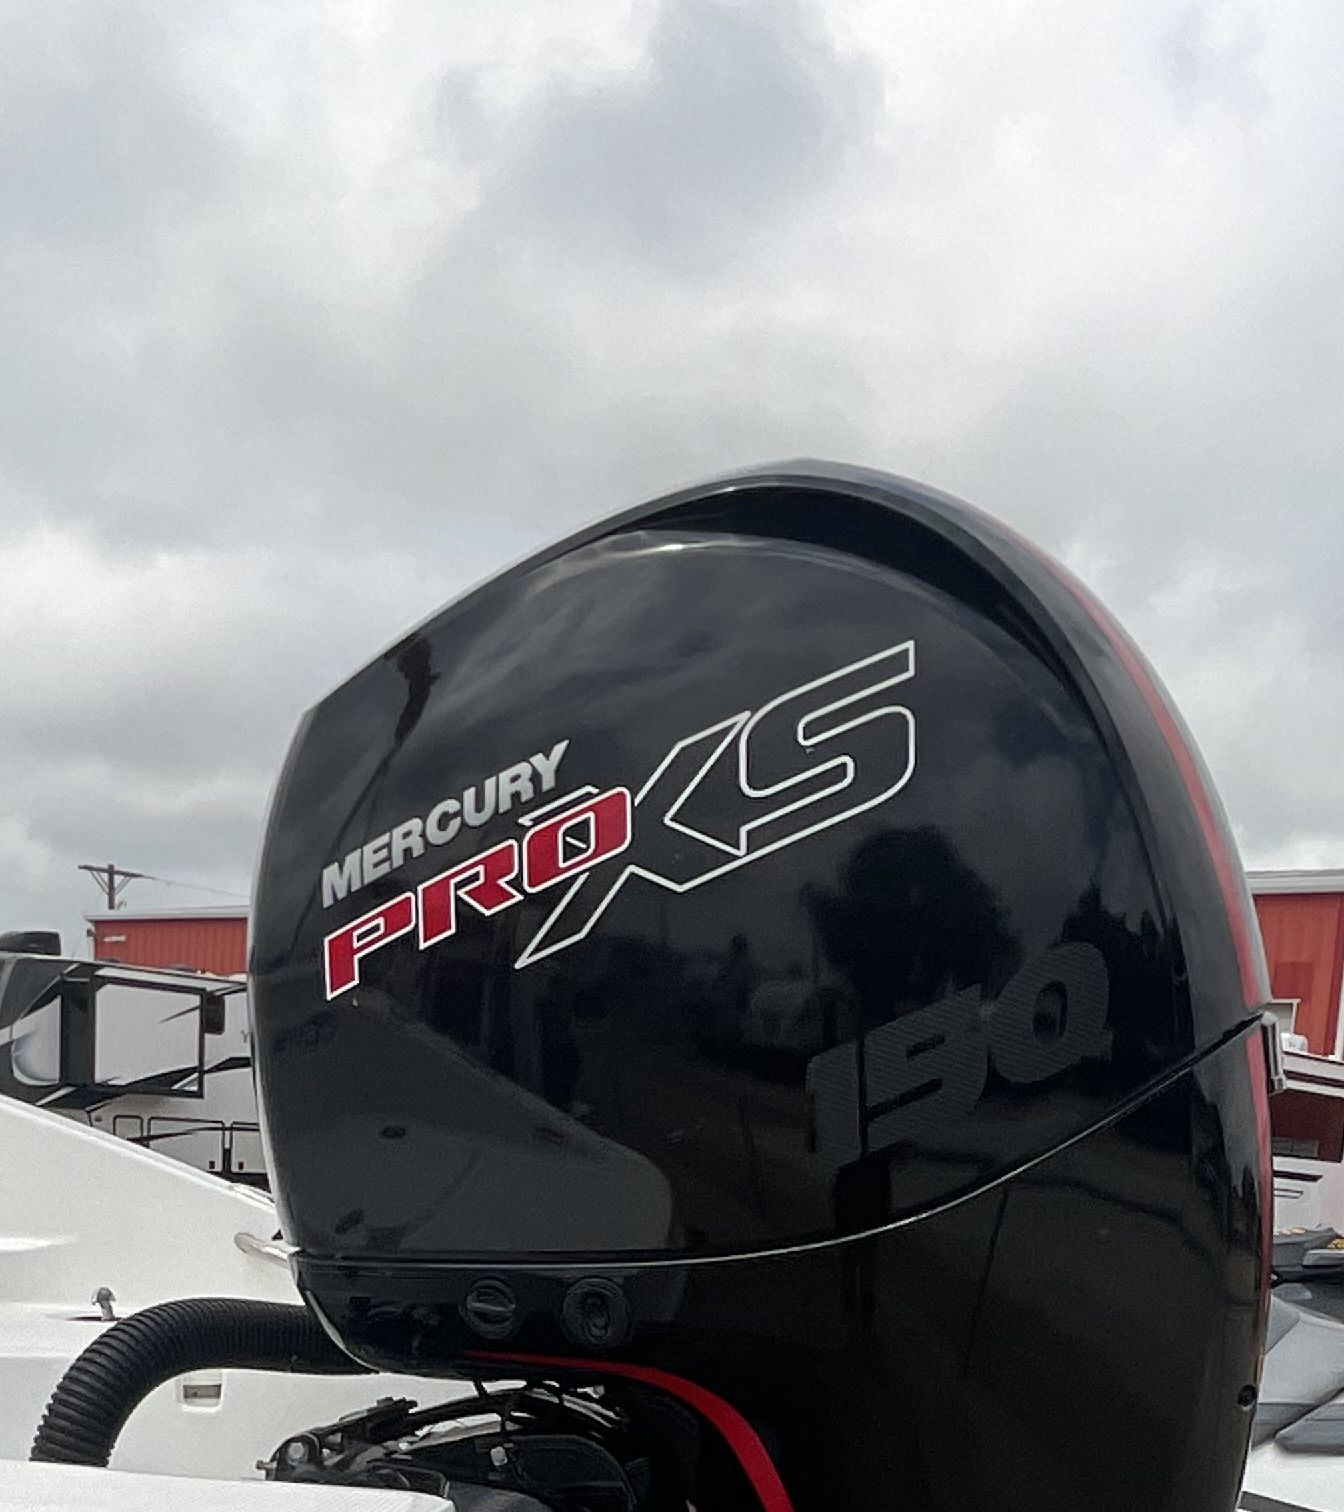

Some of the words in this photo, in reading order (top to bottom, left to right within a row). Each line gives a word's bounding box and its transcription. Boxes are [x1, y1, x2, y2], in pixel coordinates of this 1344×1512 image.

[322, 740, 569, 908] MERCURY
[323, 787, 633, 1000] PRO
[515, 640, 916, 969] XS
[806, 942, 1113, 1168] 150
